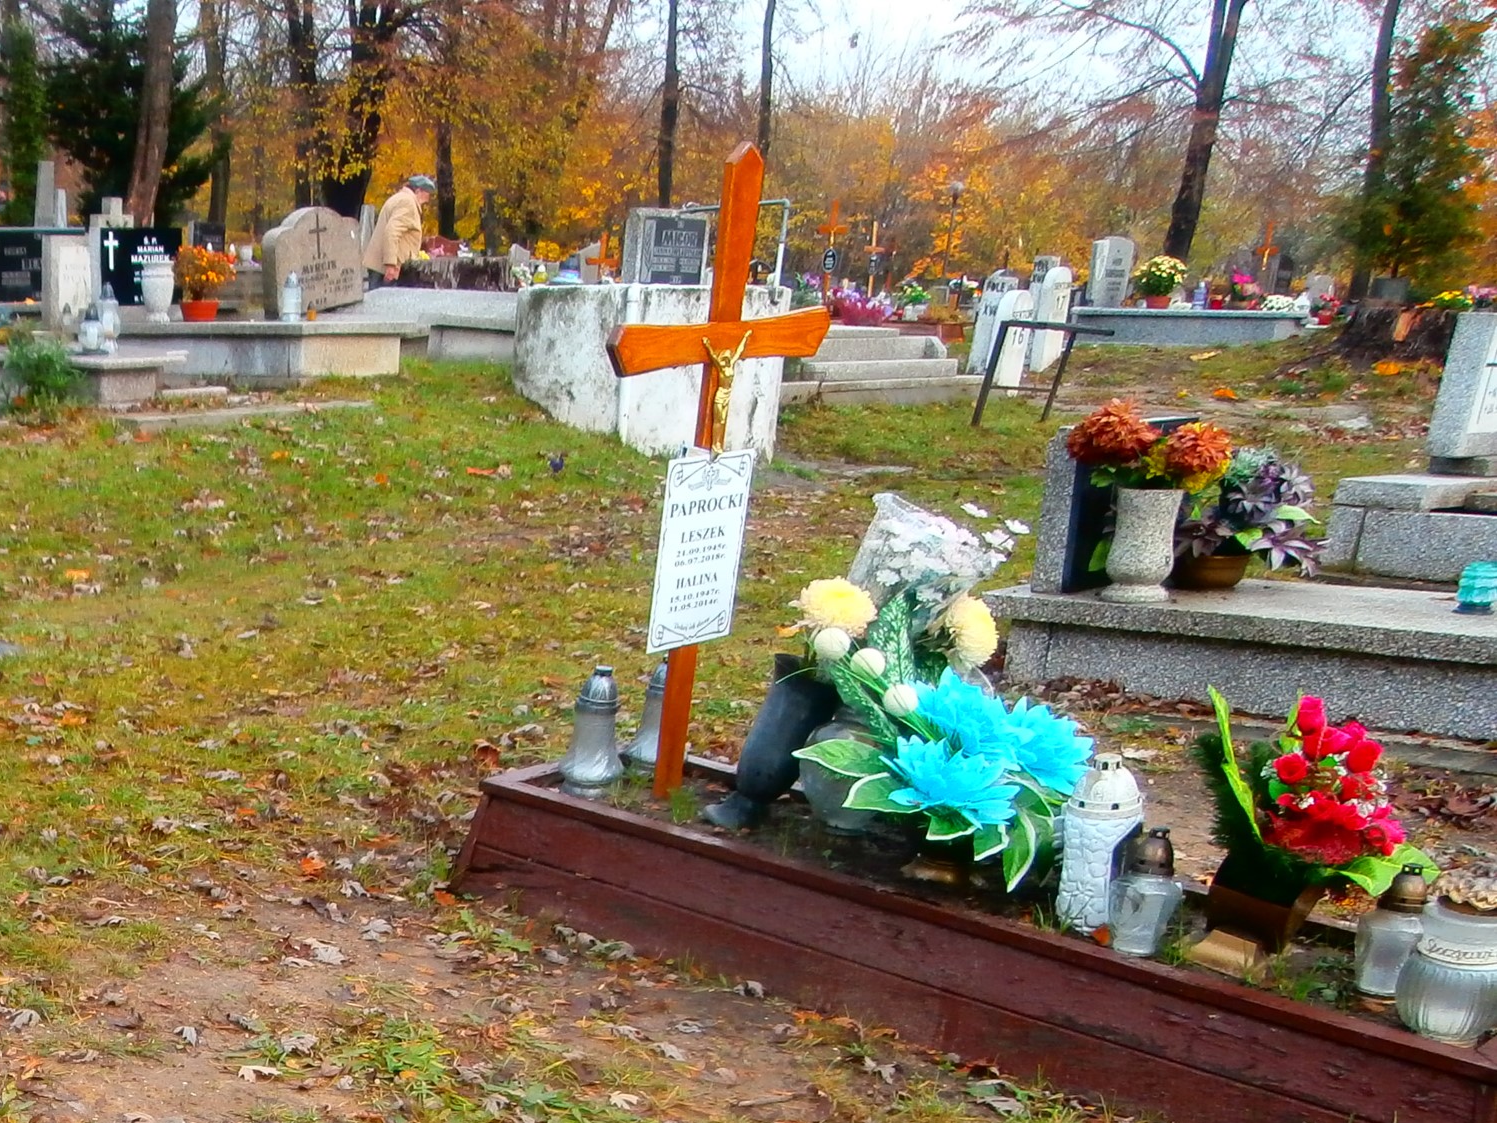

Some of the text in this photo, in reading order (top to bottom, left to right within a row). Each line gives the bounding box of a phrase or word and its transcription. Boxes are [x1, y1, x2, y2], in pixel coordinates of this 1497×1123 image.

[137, 245, 164, 253] MARIAN
[130, 255, 170, 263] MAZUREK
[1056, 296, 1066, 310] 17
[1012, 328, 1025, 345] 16
[670, 492, 744, 518] PAPROCKI
[681, 526, 726, 544] LESZEK
[676, 572, 718, 589] HALINA
